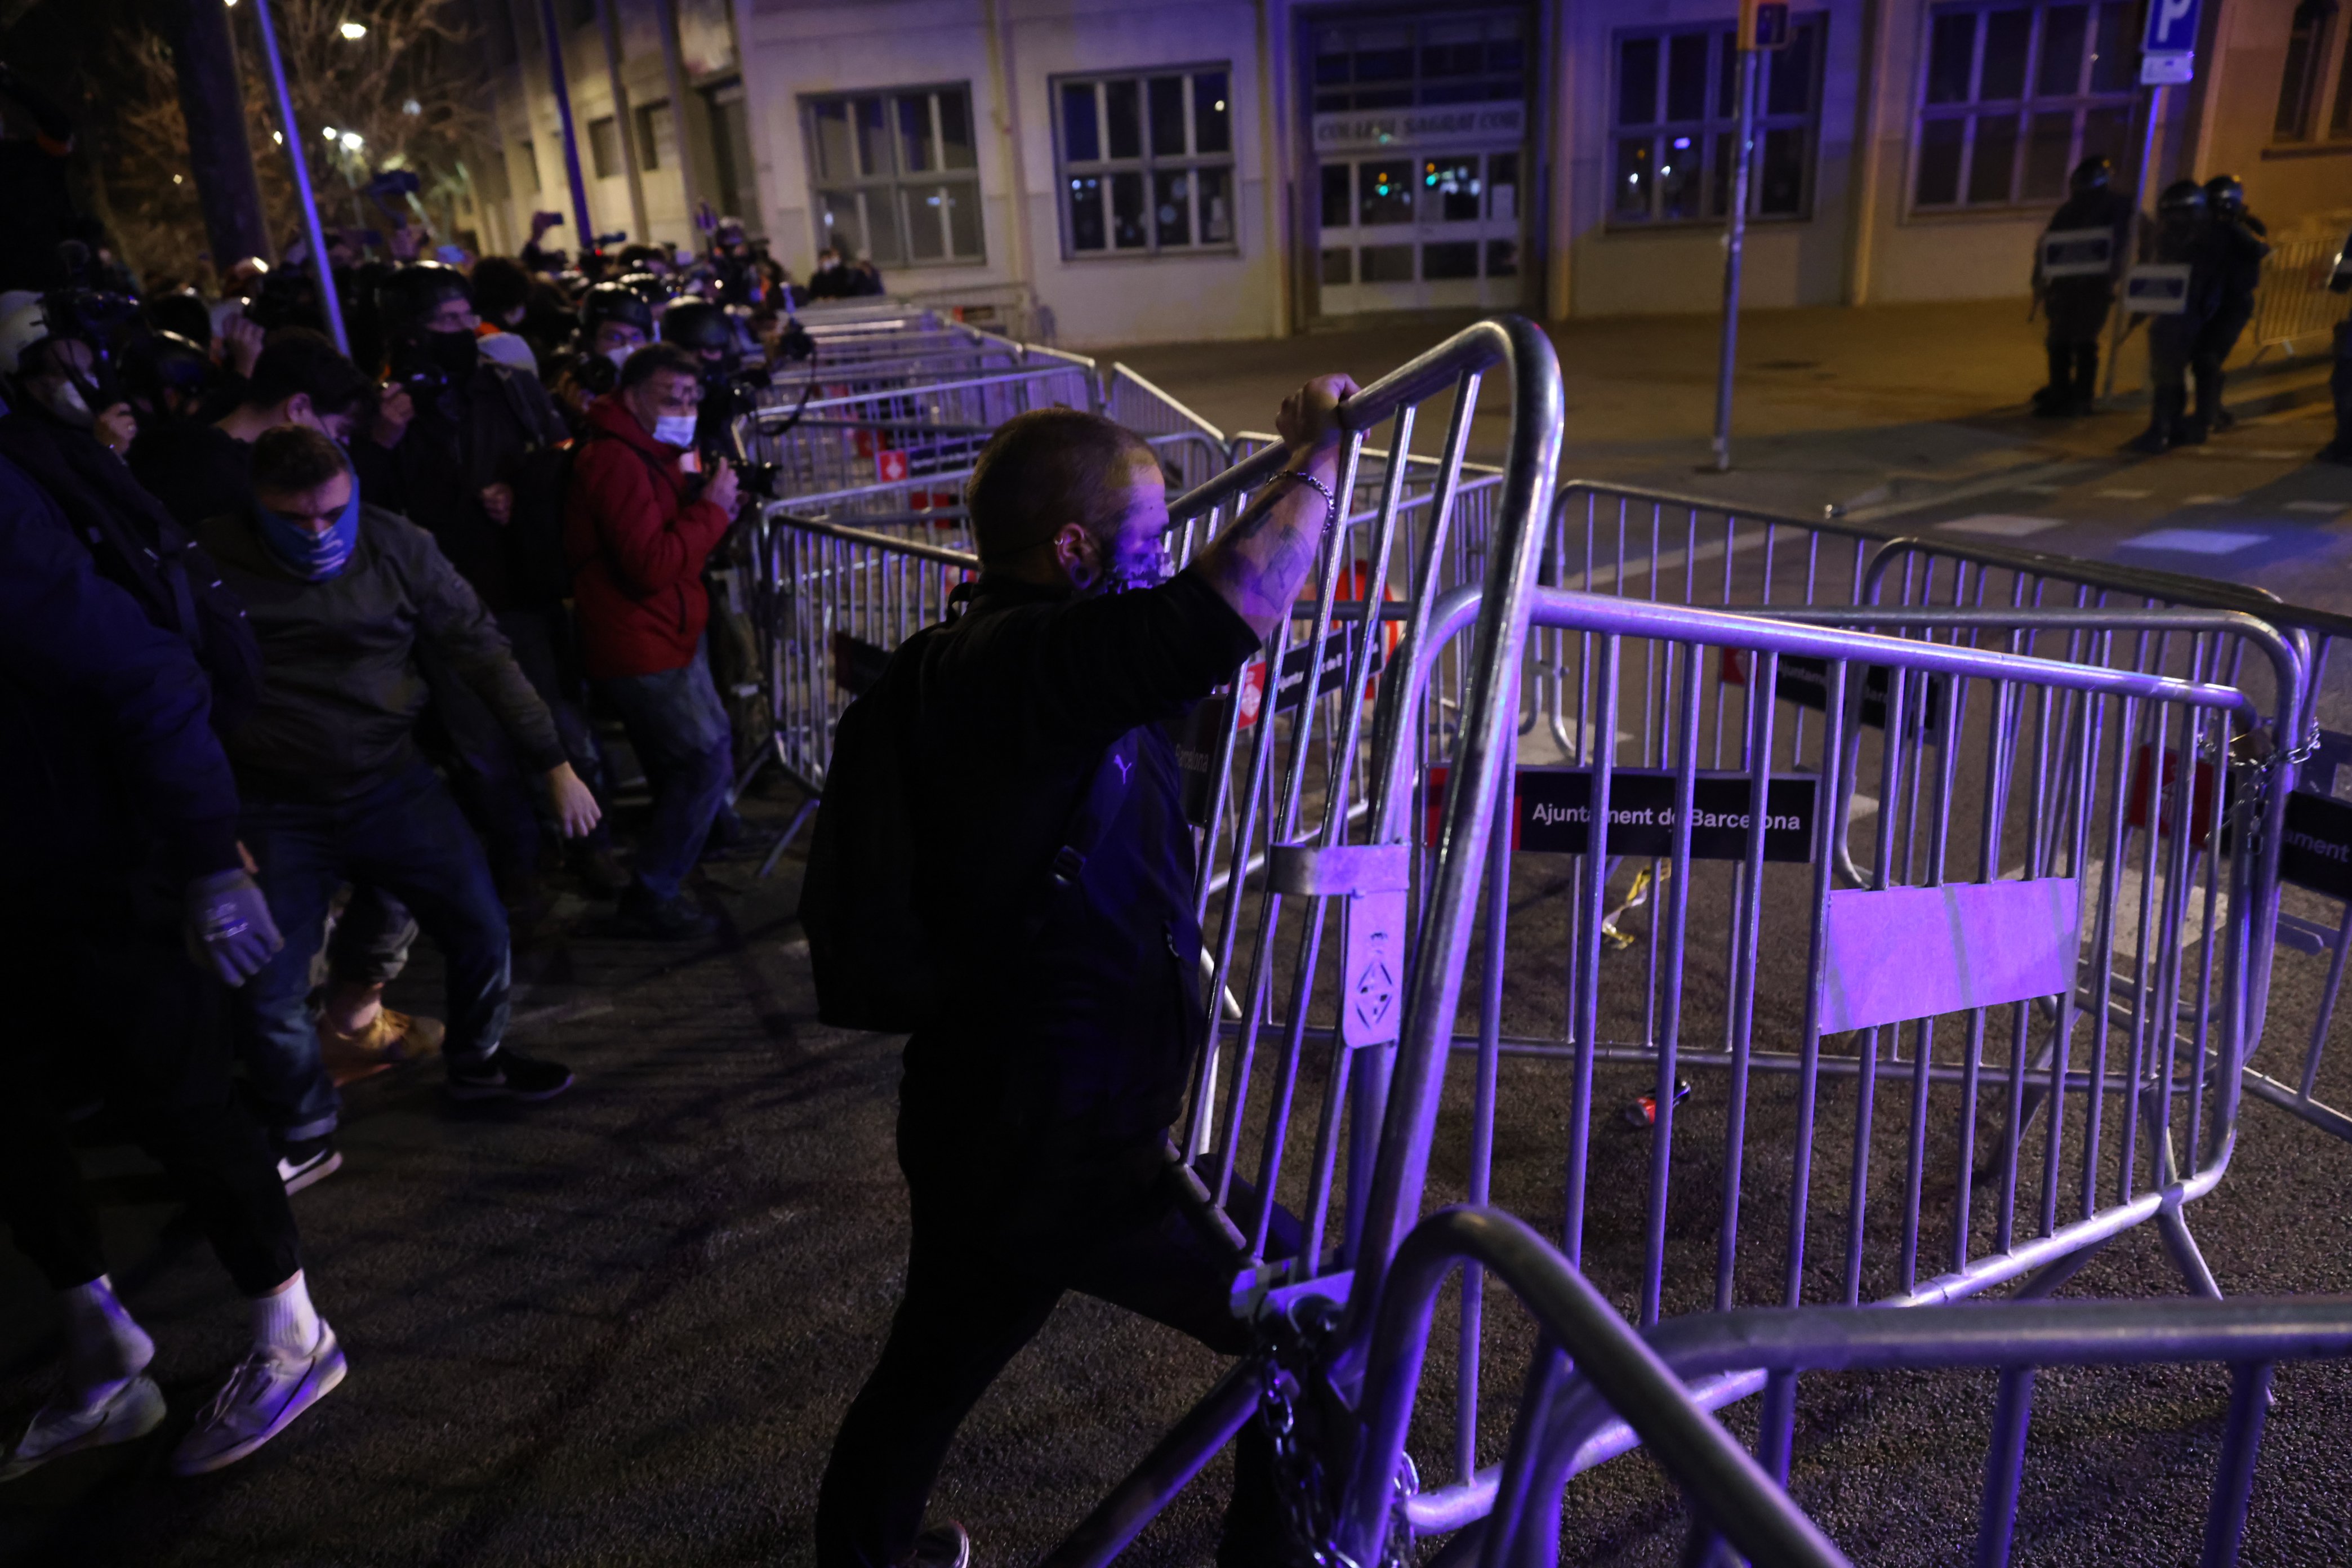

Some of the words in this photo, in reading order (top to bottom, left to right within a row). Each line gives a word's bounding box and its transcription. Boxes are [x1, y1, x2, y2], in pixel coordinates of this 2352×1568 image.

[2156, 0, 2192, 43] P
[1531, 802, 1654, 826] Ajuntment
[1691, 808, 1801, 831] Barceona
